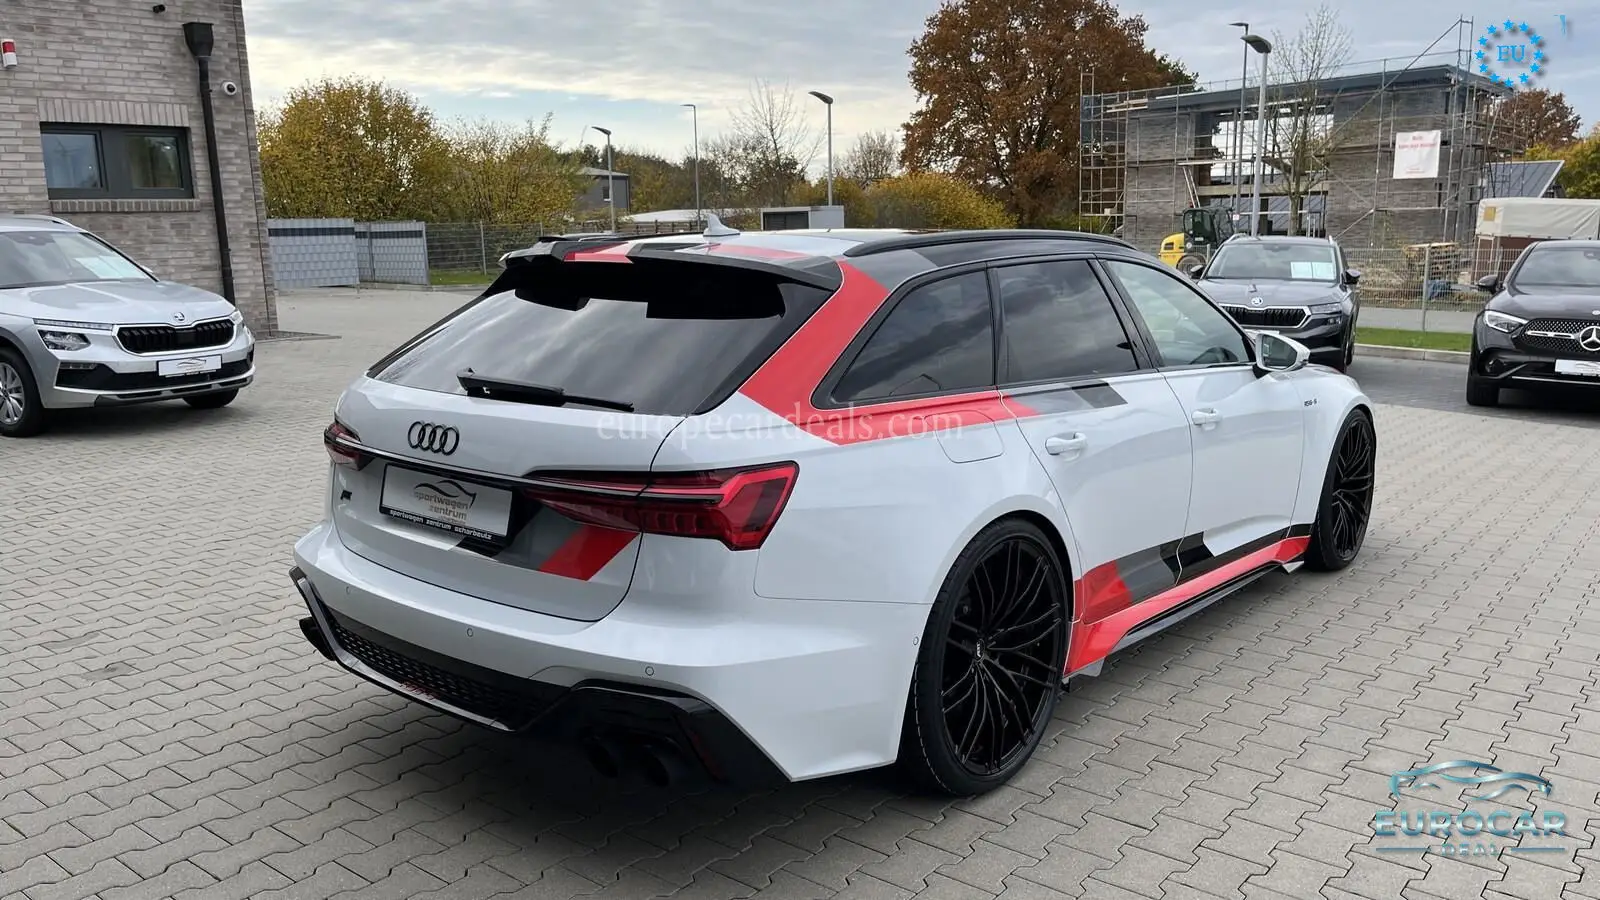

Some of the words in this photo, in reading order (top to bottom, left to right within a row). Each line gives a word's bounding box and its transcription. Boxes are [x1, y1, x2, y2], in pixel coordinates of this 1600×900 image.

[414, 490, 468, 510] sportwagen
[430, 505, 466, 520] zentrum
[390, 509, 424, 523] sportwagen
[426, 519, 451, 530] zentrum
[454, 526, 492, 540] scharbeutz
